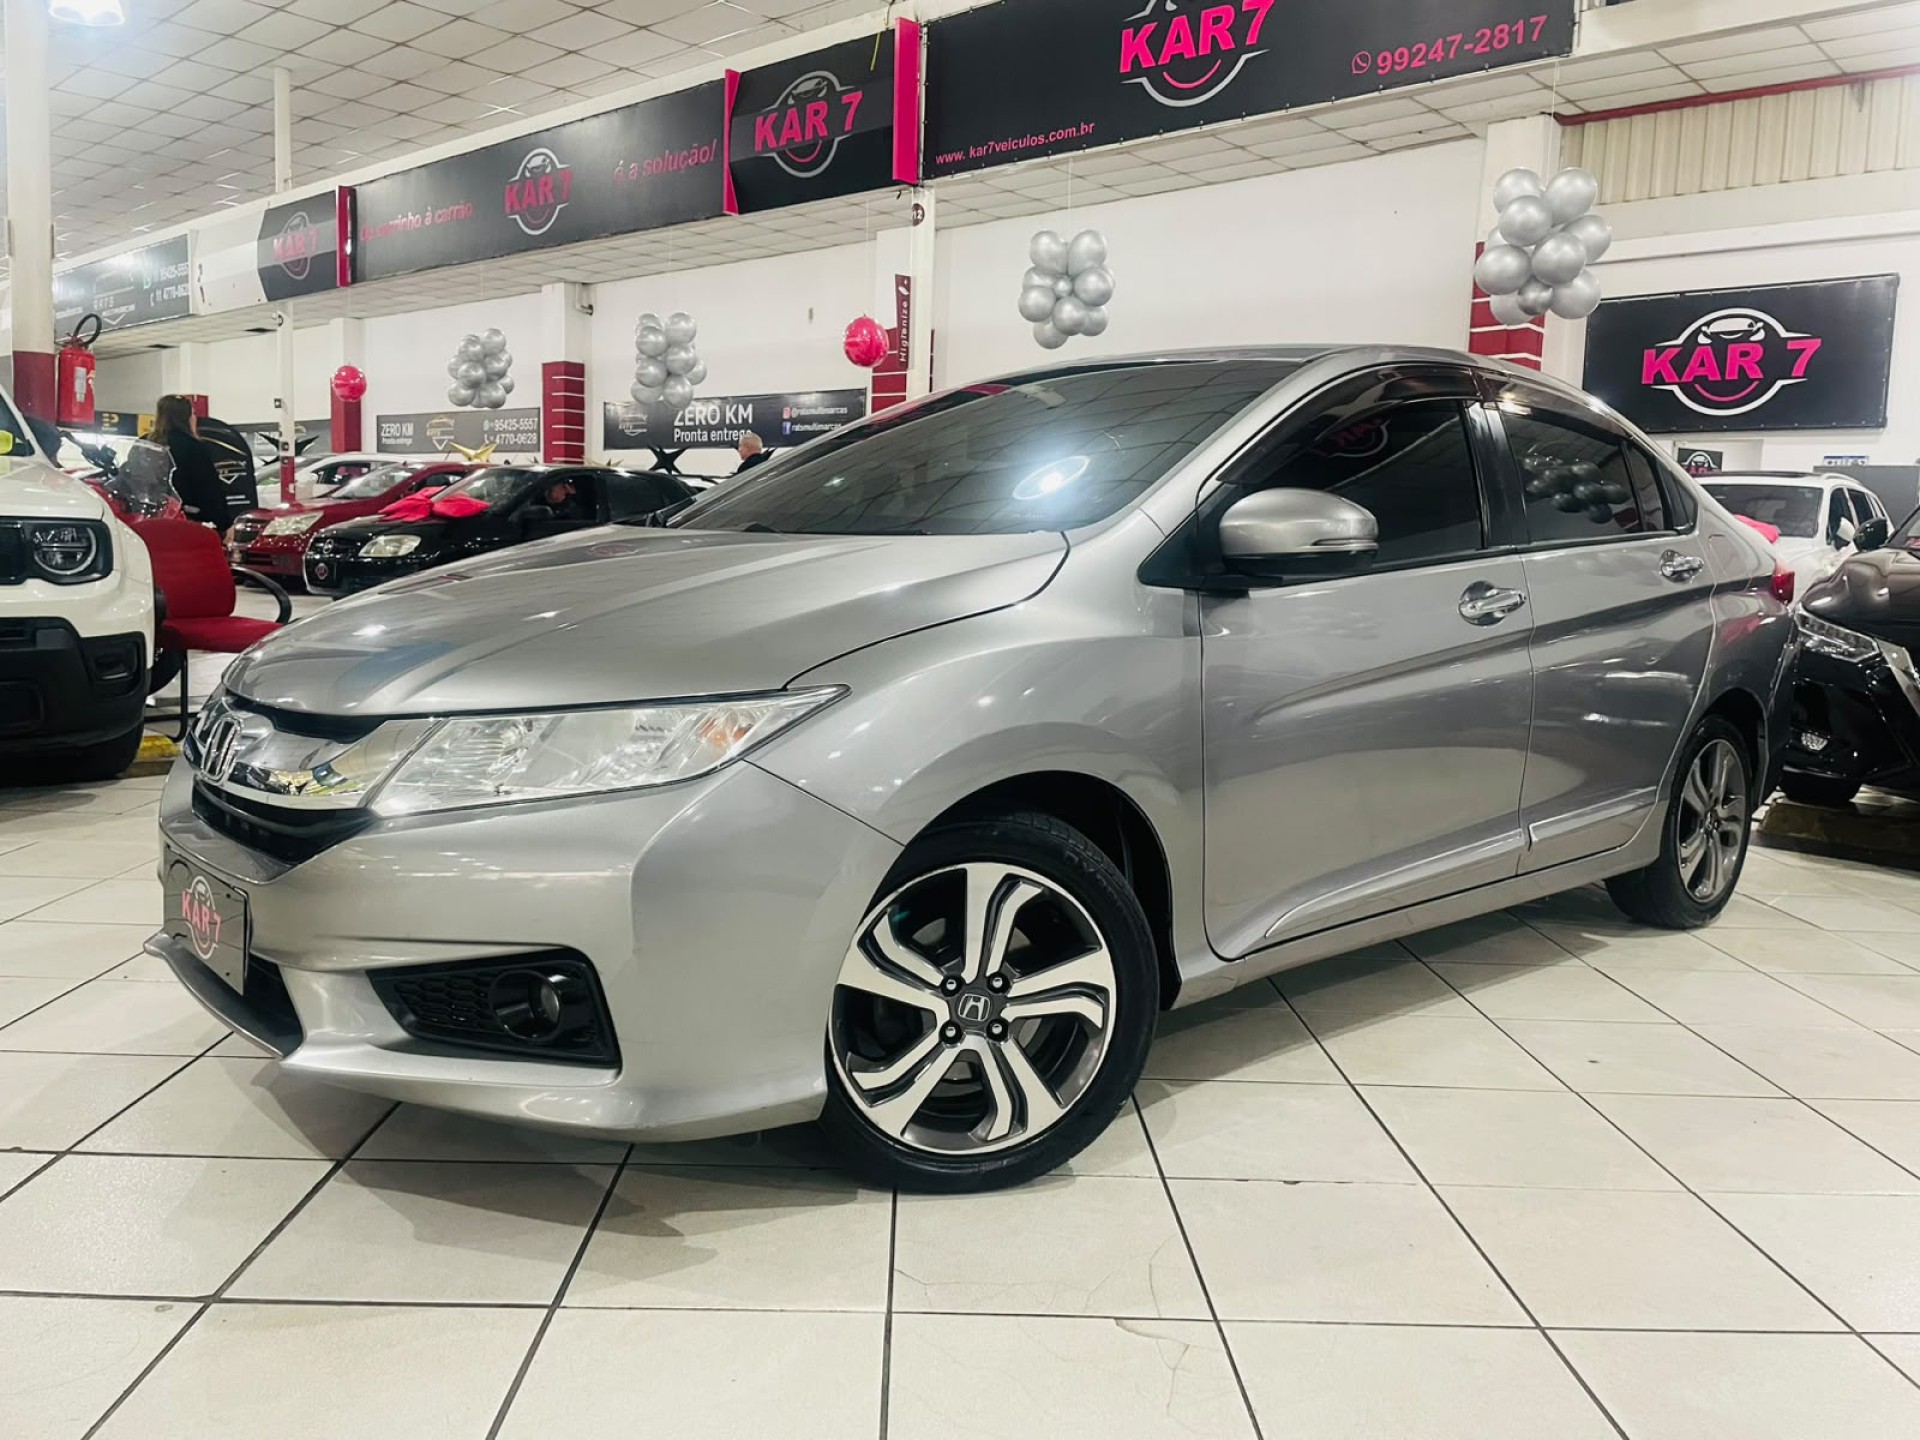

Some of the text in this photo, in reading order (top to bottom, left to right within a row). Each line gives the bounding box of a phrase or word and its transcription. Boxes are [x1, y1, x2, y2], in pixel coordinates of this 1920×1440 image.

[1377, 15, 1548, 75] 99247-2817
[754, 90, 863, 152] KAR 7
[504, 169, 574, 214] KAR 7
[1641, 338, 1822, 384] KAR 7
[381, 422, 401, 437] ZERO
[673, 428, 708, 442] Pronta
[725, 403, 753, 424] KM
[181, 889, 222, 942] KAR 7
